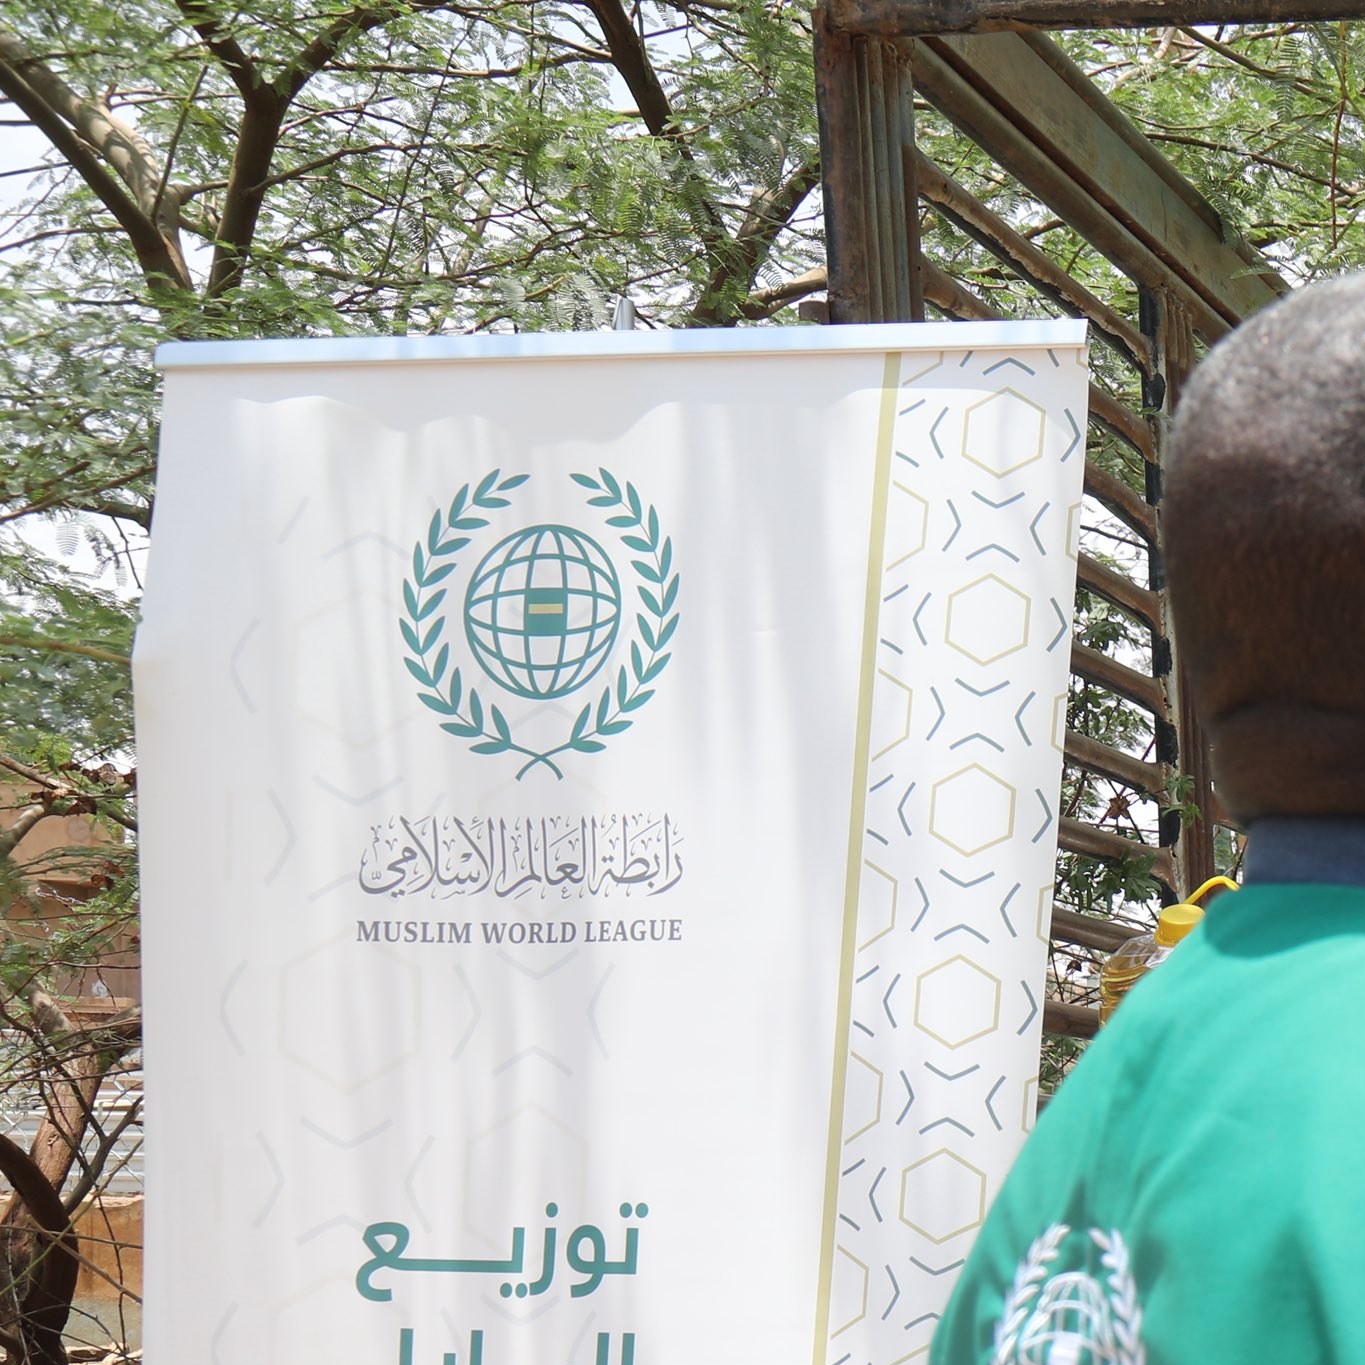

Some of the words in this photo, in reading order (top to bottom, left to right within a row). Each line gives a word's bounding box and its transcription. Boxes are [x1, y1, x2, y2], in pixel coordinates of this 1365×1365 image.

[356, 920, 472, 944] MUSLIM
[481, 922, 577, 943] WORLD
[584, 918, 683, 942] LEAGUE
[355, 1201, 649, 1302] توزيع
